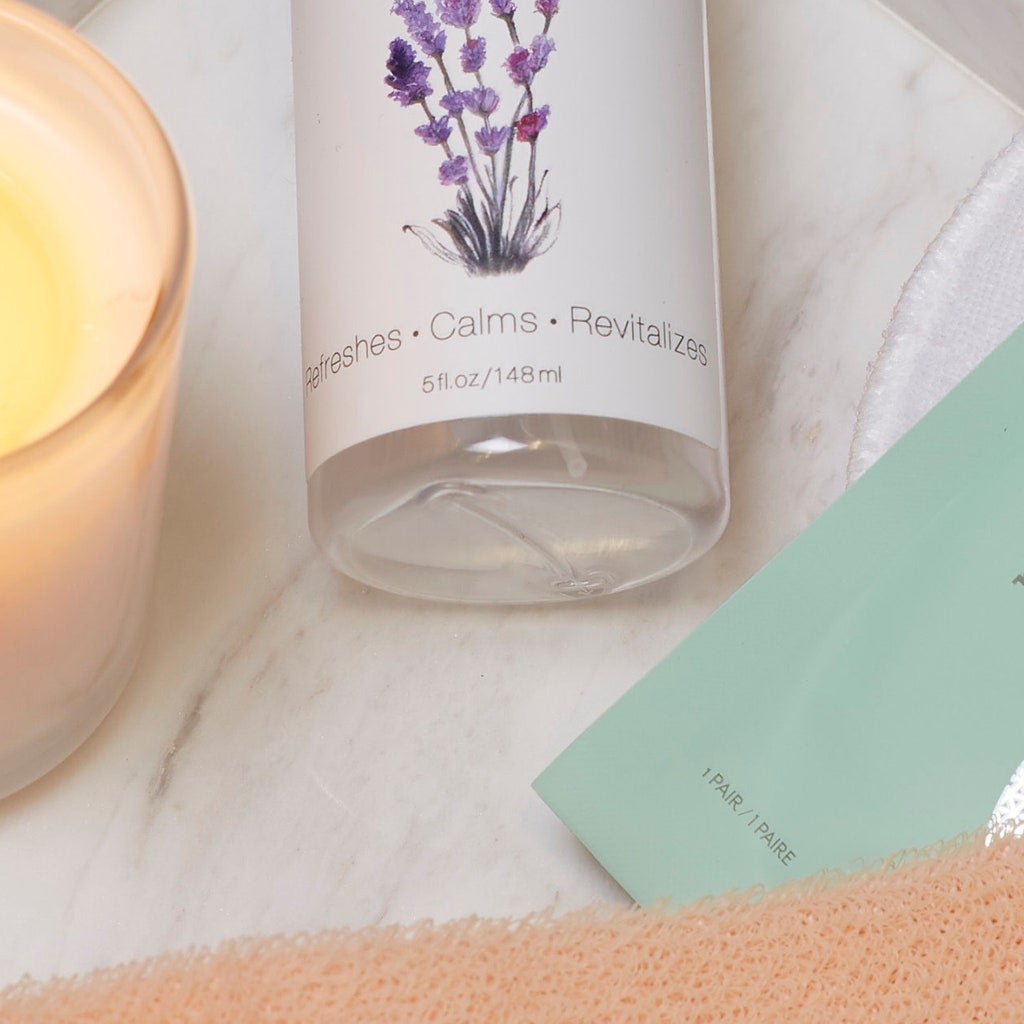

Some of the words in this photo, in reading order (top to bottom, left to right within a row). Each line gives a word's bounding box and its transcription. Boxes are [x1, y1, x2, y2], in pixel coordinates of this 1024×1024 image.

[305, 328, 402, 397] Refreshes
[430, 307, 538, 341] Calms
[570, 306, 708, 366] Revitalizes
[702, 767, 711, 777] 1
[708, 772, 744, 812] PAIR
[747, 814, 759, 827] 1
[753, 821, 796, 867] PAIRE
